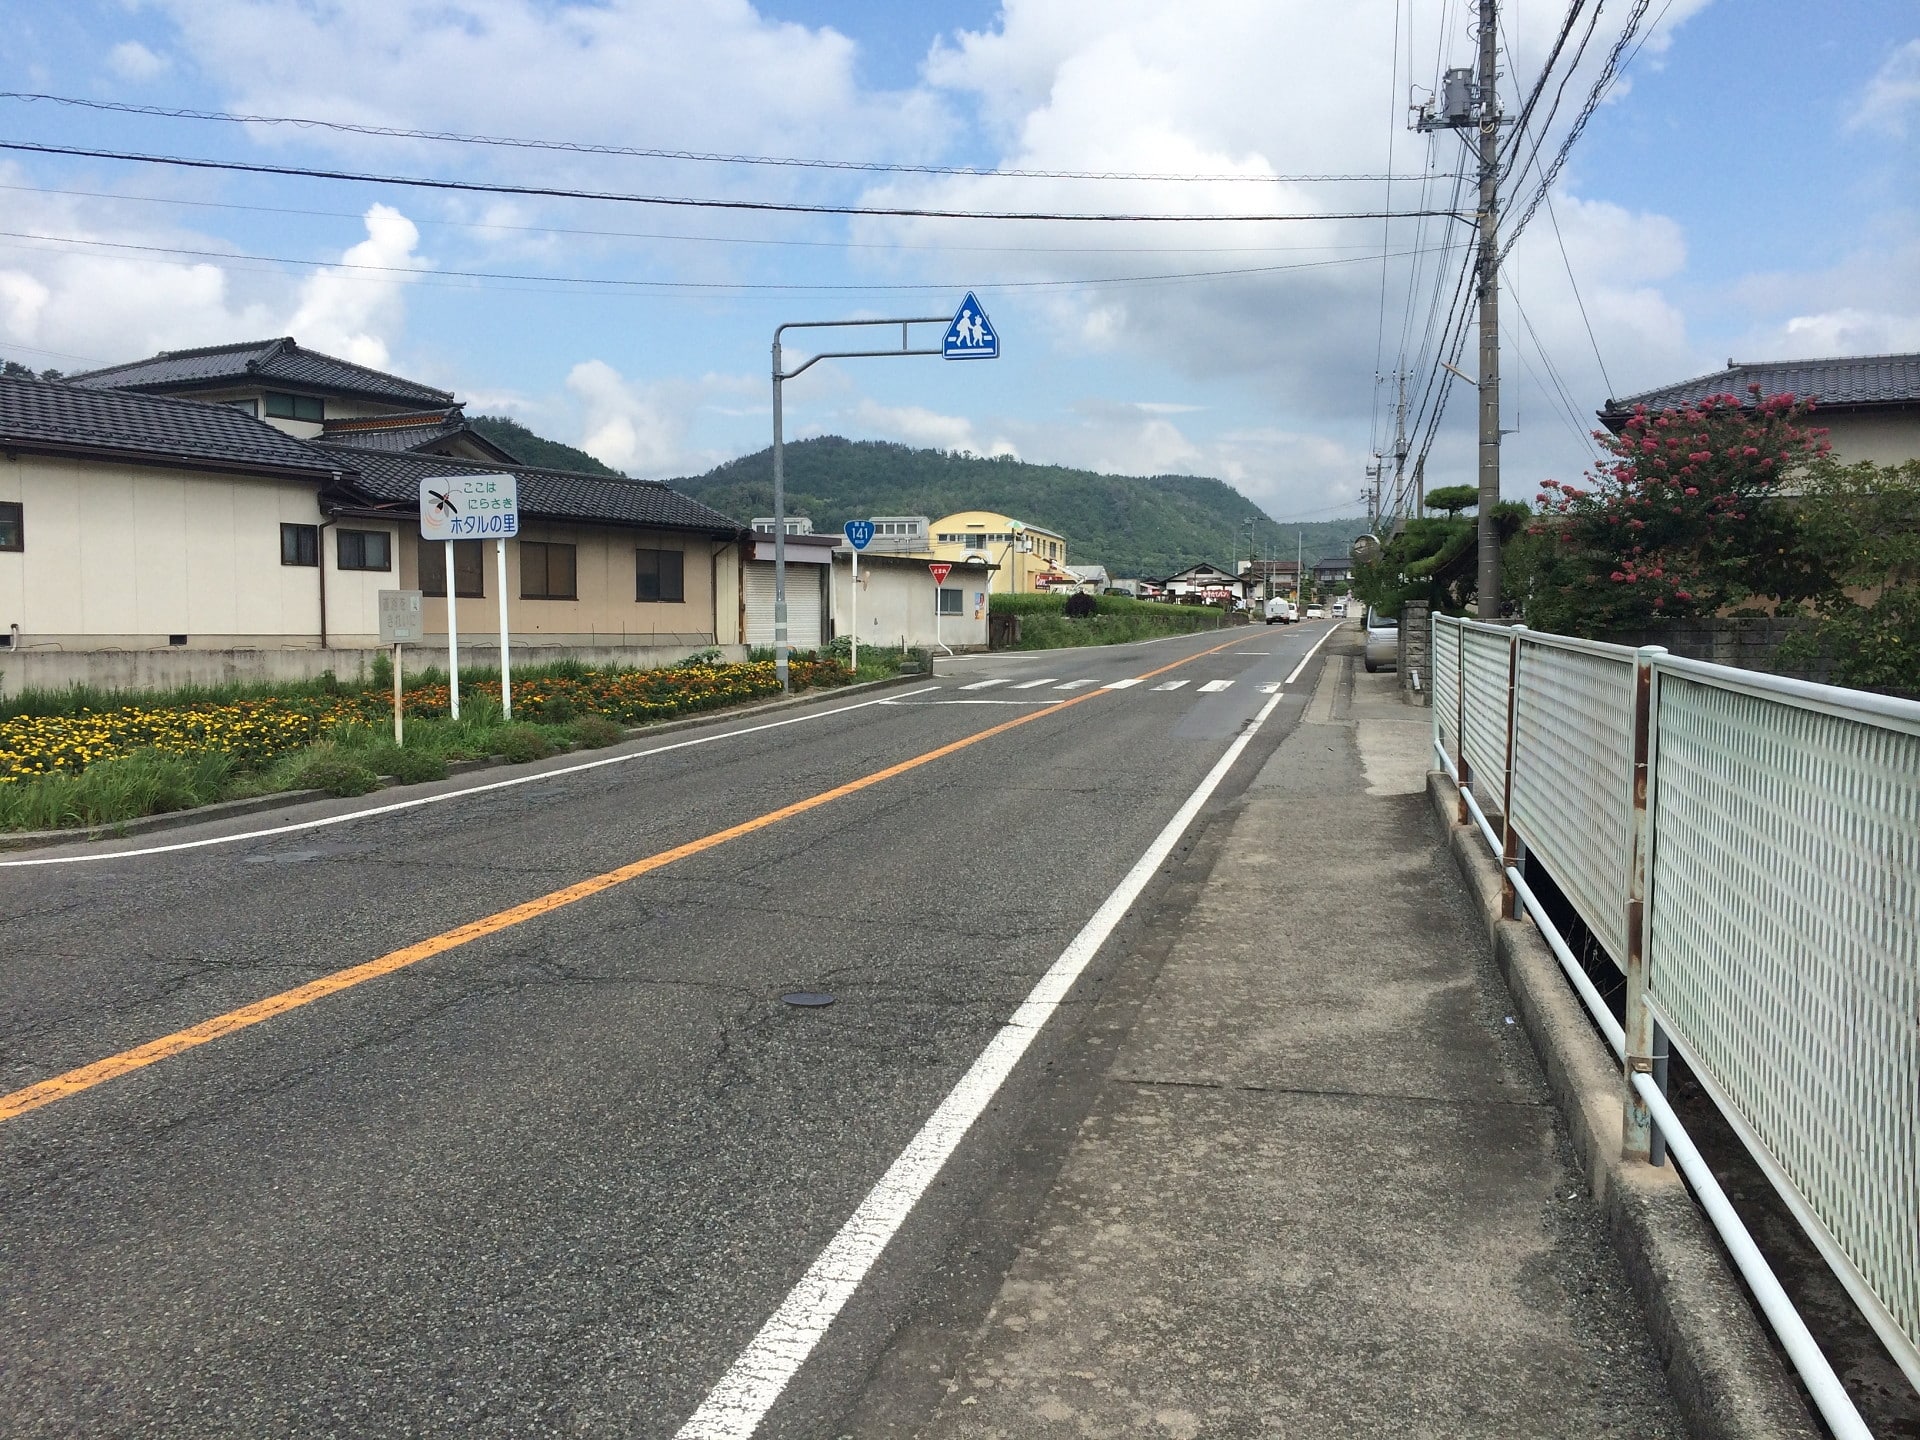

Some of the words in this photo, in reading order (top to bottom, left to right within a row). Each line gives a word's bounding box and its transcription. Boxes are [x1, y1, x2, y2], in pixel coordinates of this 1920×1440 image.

[464, 482, 496, 493] ここは
[468, 498, 512, 510] にらさき
[451, 514, 516, 534] ホタルの里
[852, 527, 868, 539] 141
